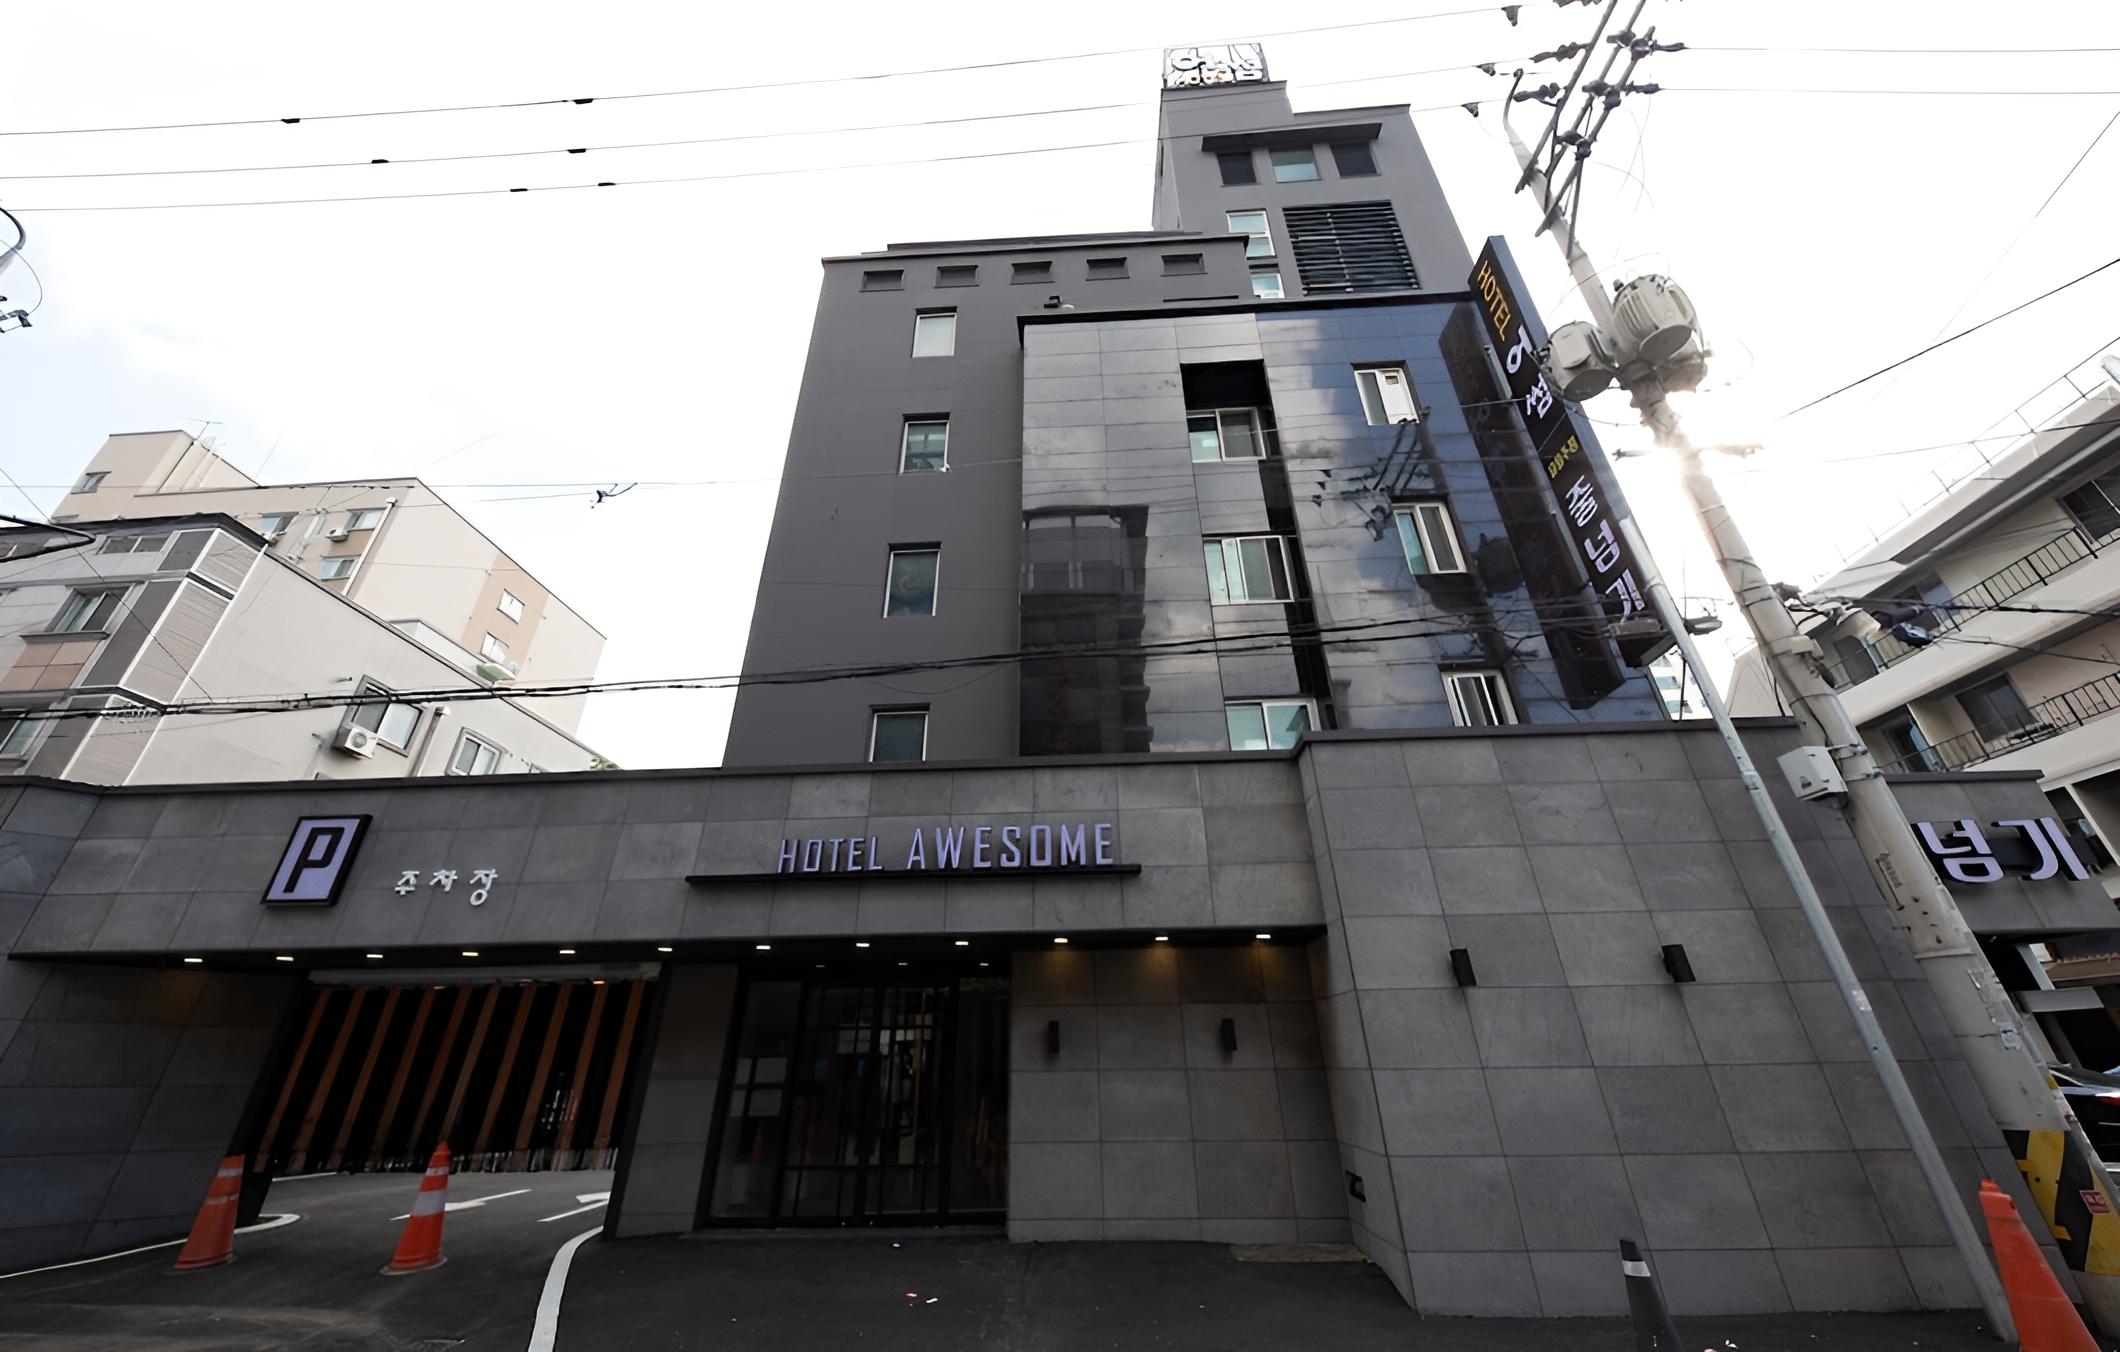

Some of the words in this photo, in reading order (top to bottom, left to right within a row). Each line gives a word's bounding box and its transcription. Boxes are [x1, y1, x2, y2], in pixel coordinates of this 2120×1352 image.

[1477, 260, 1512, 342] HOTEL
[1506, 323, 1553, 419] 어썸
[1565, 474, 1646, 624] 줄넘기
[283, 826, 345, 894] P
[777, 836, 883, 874] HOTEL
[906, 823, 1114, 870] AWESOME
[394, 868, 499, 906] 주차장
